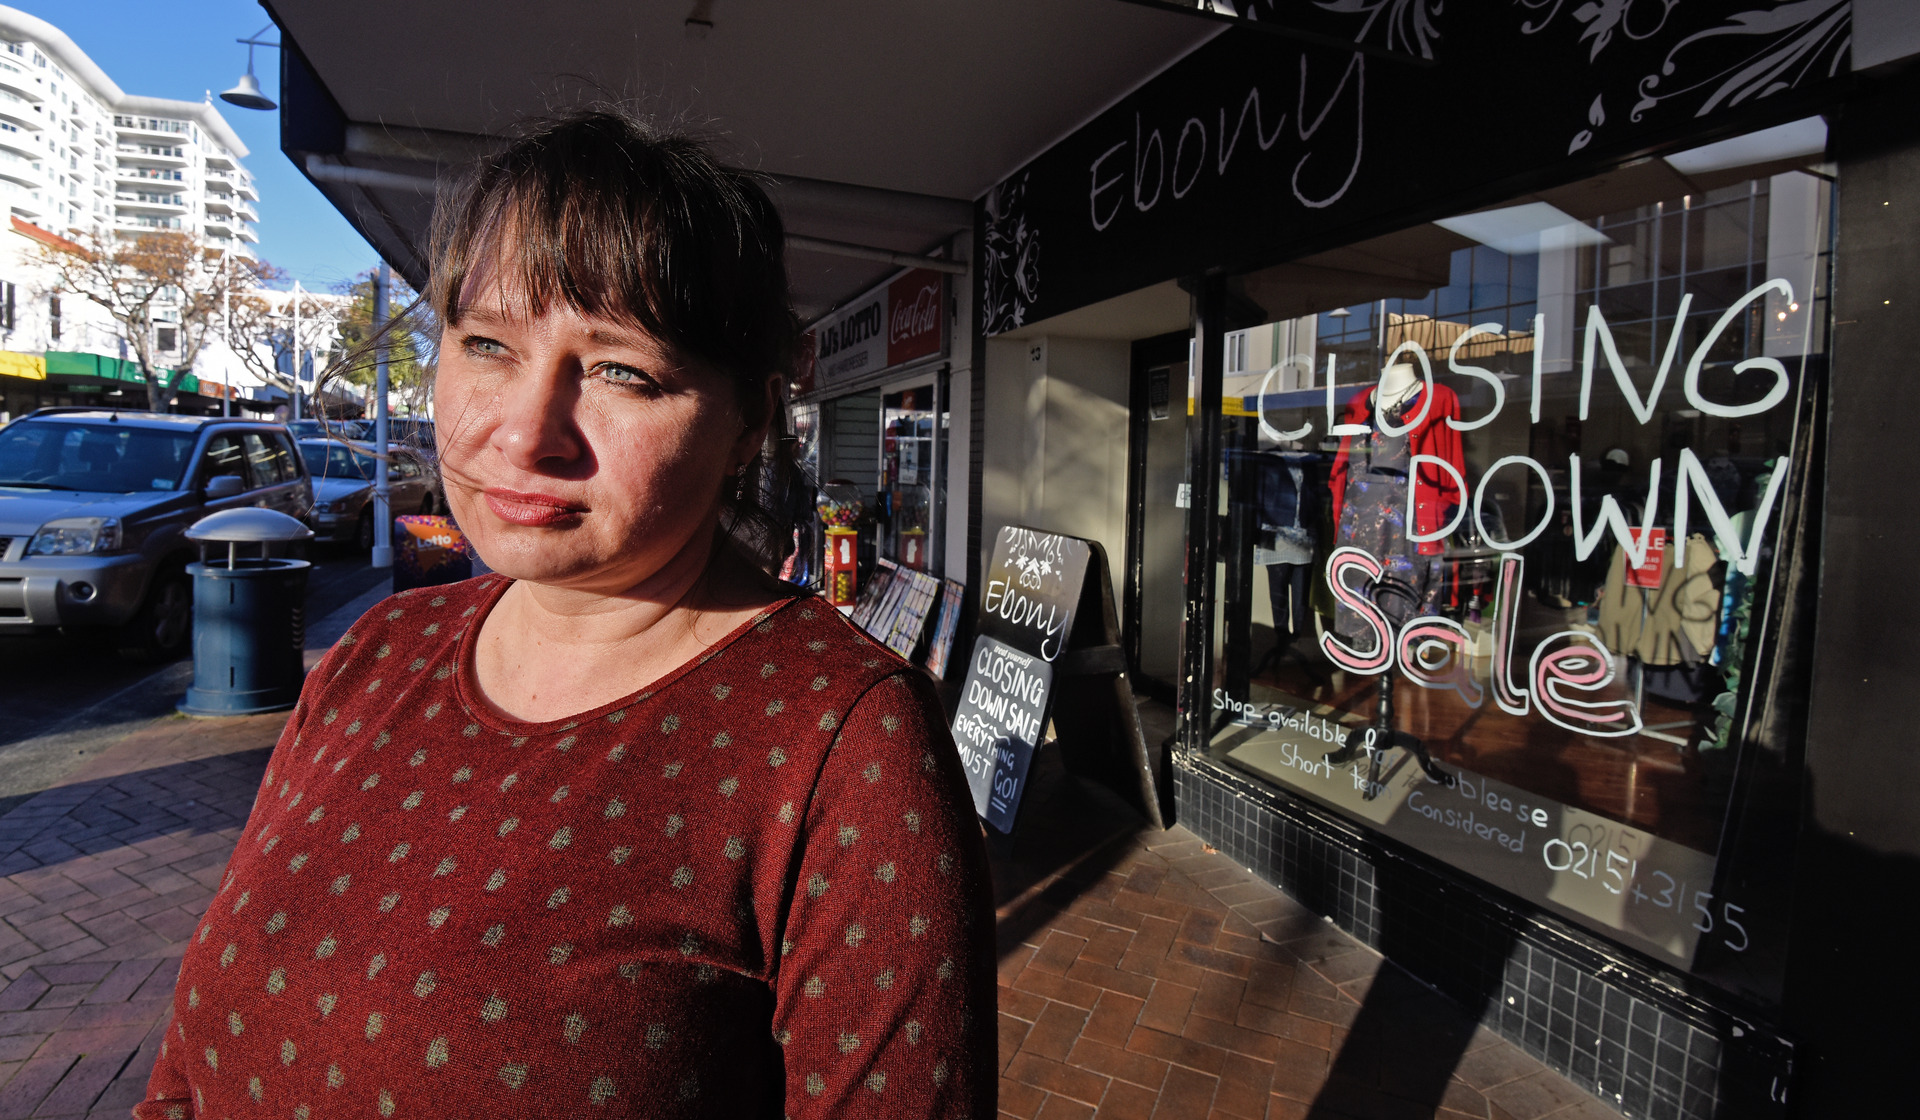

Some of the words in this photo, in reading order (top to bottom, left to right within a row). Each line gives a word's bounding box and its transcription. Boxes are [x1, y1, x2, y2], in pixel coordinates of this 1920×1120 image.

[1089, 51, 1365, 232] Ebony
[840, 301, 881, 351] LOTTO
[1258, 278, 1794, 441] CLOSING
[416, 534, 452, 549] Lotto
[1405, 447, 1789, 576] DOWN
[985, 576, 1069, 662] Ebony
[1319, 546, 1644, 737] Sale
[976, 646, 1044, 708] CLOSING
[1006, 649, 1034, 669] yourself
[956, 713, 1015, 771] EVERYTHING
[968, 679, 1009, 723] DOWN
[1005, 702, 1041, 747] SALE
[1213, 687, 1263, 723] Shop
[1268, 710, 1347, 748] available
[957, 742, 992, 780] MUST
[1280, 742, 1335, 779] Short
[1350, 765, 1393, 800] term
[1407, 790, 1526, 854] Considered
